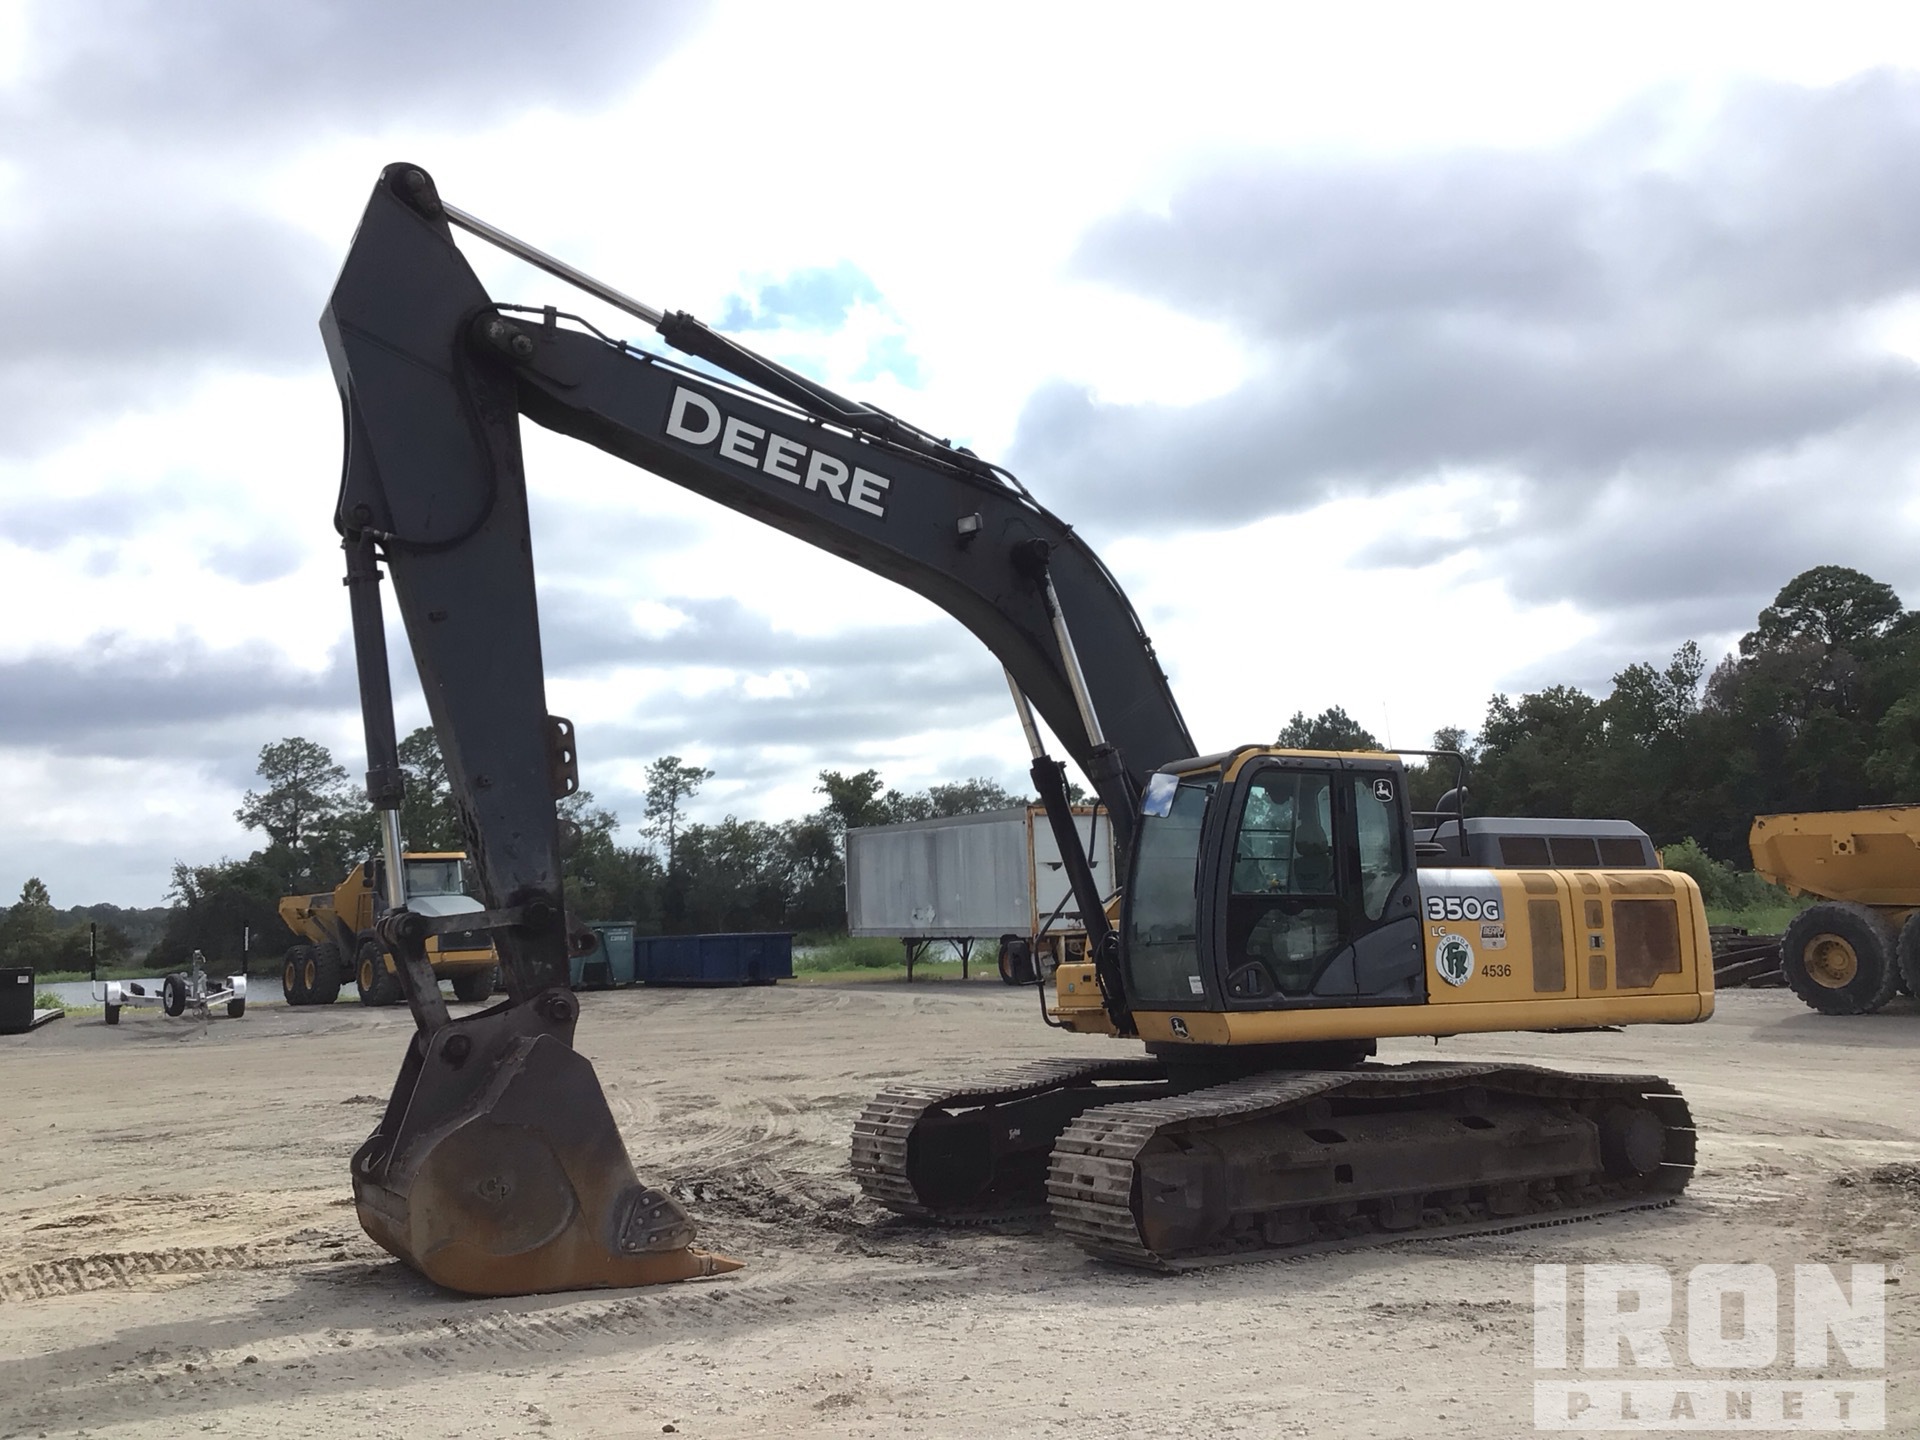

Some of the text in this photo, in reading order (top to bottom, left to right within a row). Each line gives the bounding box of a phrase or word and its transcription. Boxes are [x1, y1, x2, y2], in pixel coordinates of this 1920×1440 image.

[666, 386, 890, 518] DEERE
[1427, 896, 1499, 920] 350G
[1431, 926, 1446, 937] LC
[1439, 935, 1469, 952] FLORIDA
[1481, 964, 1511, 977] 4536
